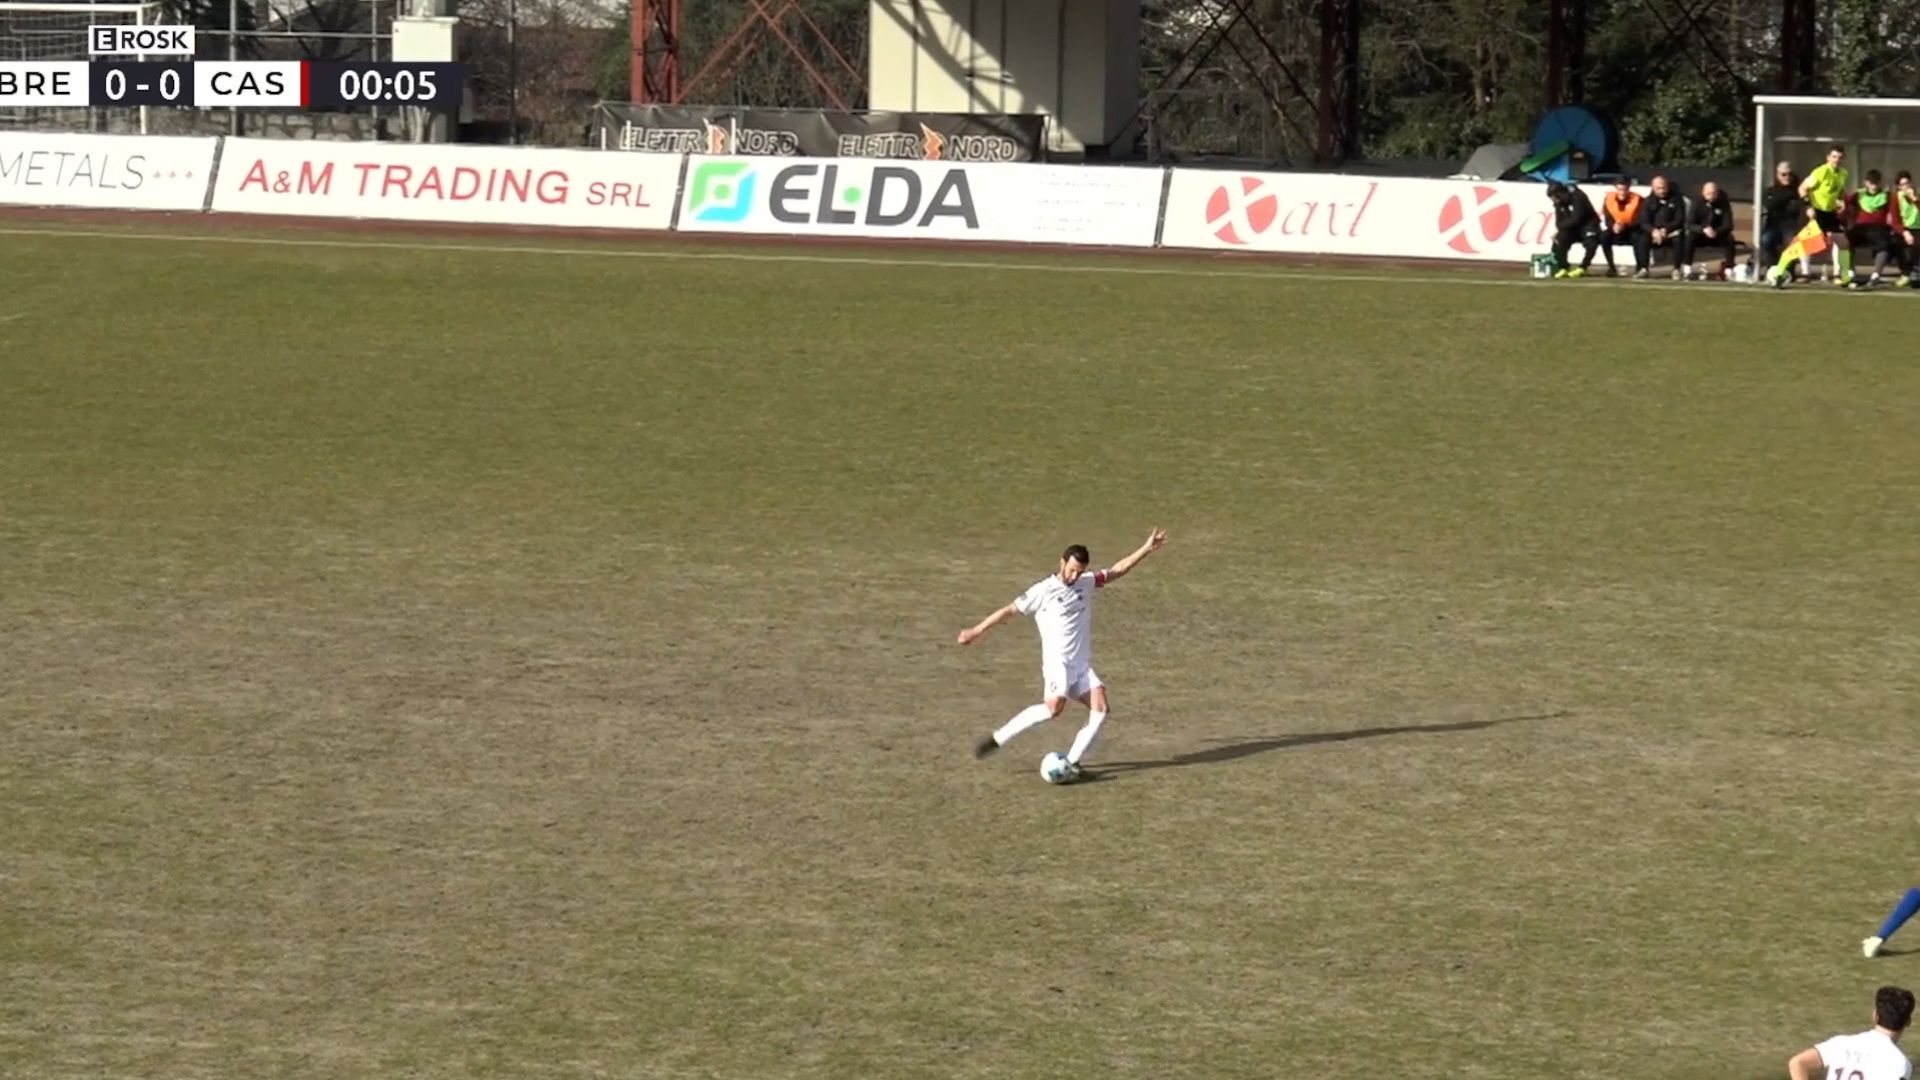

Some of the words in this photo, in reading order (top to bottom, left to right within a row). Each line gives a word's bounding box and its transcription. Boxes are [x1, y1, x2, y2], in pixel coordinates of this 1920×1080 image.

[0, 150, 146, 190] METALS
[239, 159, 335, 195] A&M
[353, 164, 570, 205] TRADING
[585, 181, 652, 208] SRL
